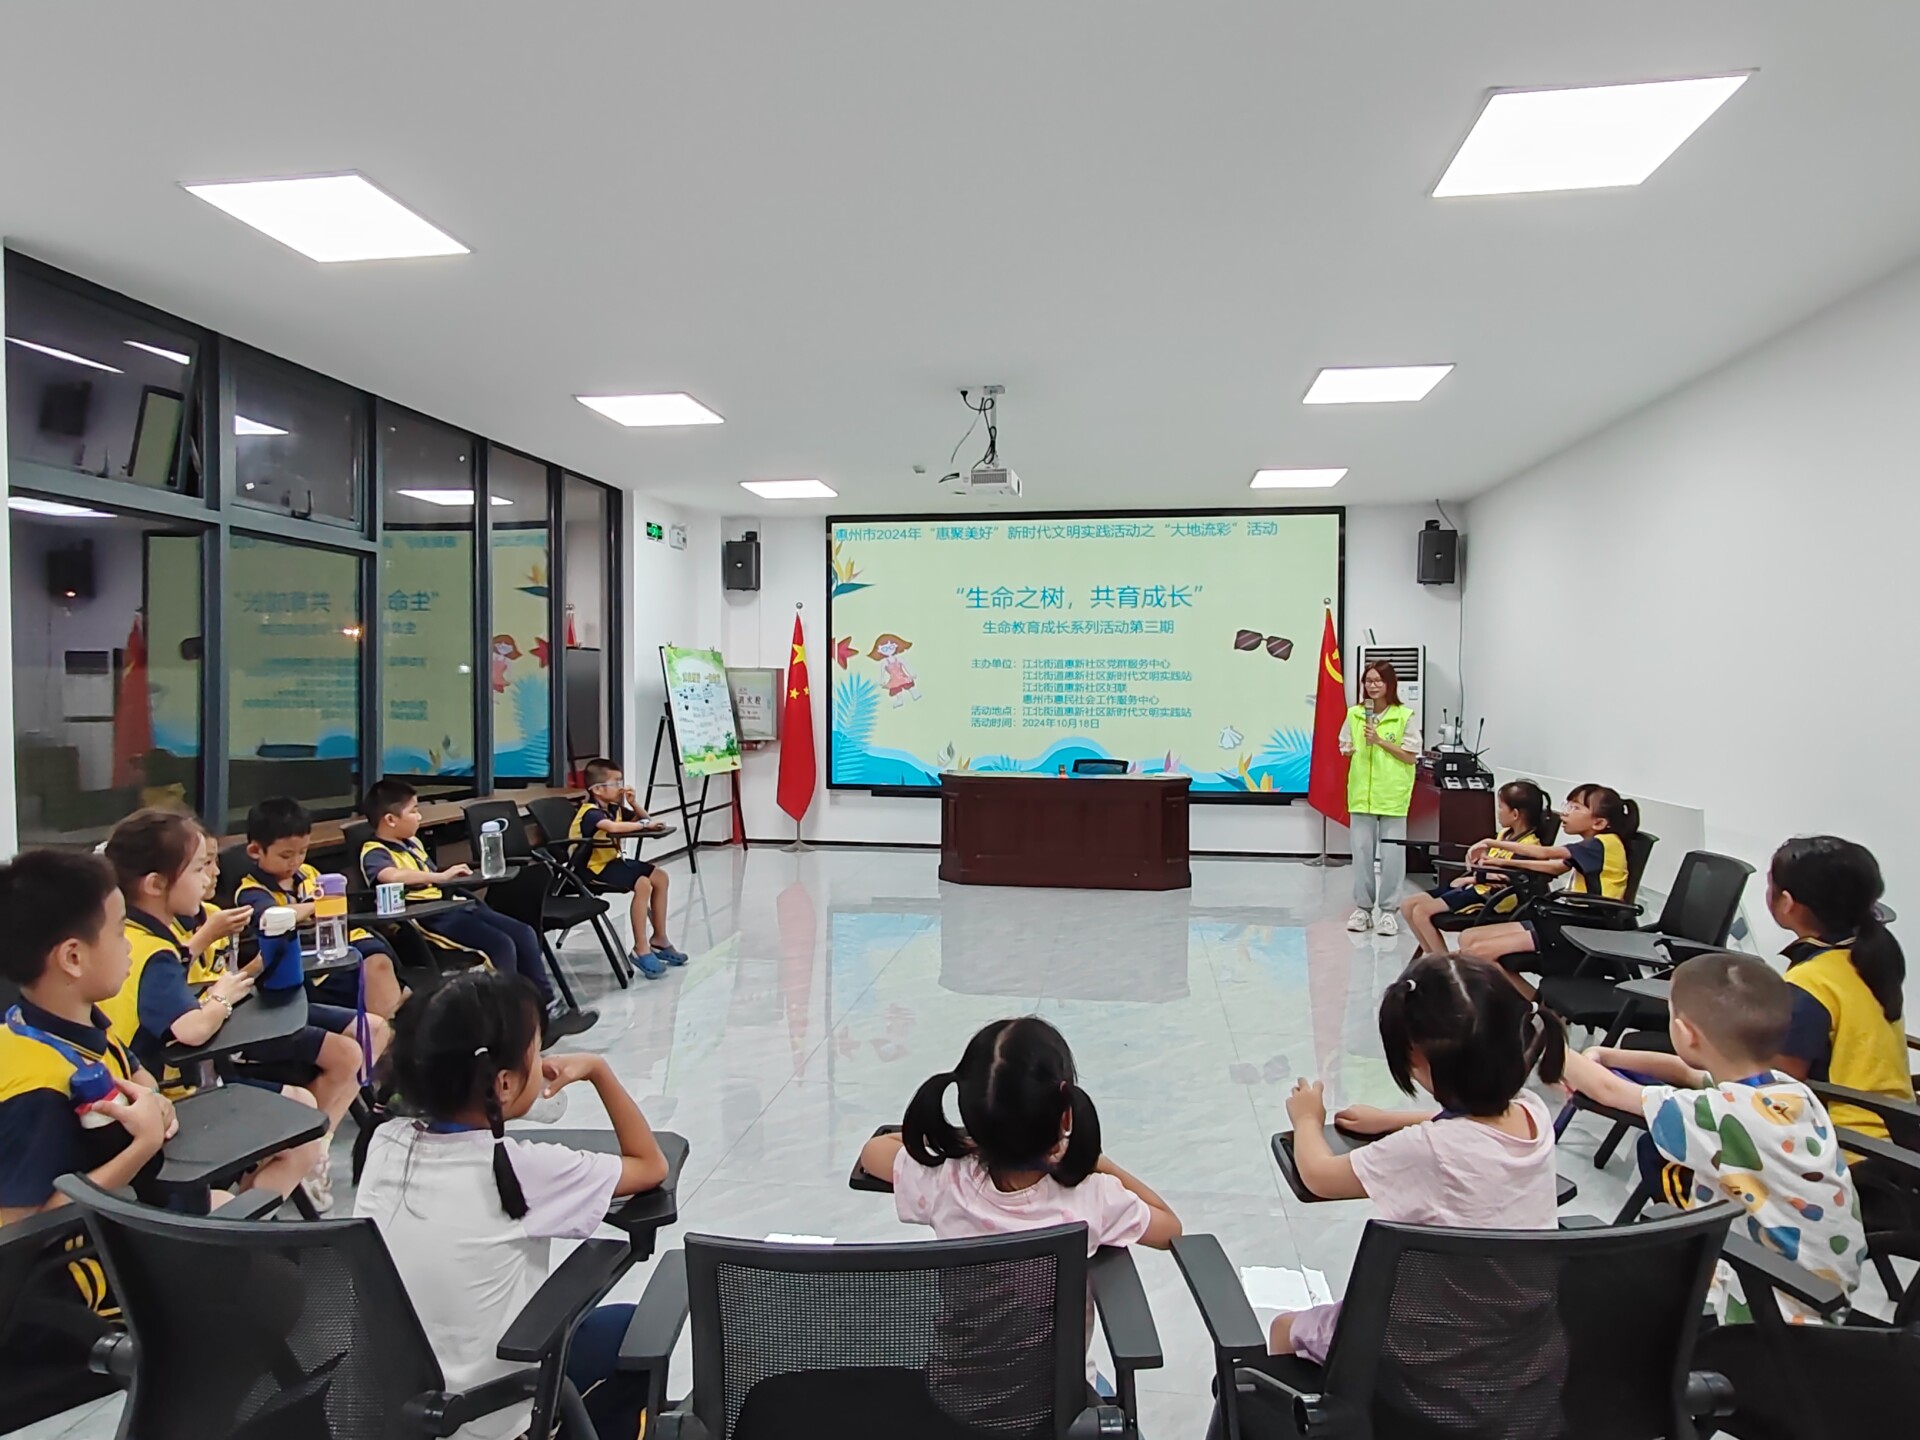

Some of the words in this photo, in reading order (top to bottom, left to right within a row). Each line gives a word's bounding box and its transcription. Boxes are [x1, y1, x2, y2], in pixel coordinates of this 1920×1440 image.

[956, 585, 1203, 610] “生命之树，共育成长”
[982, 619, 1175, 635] 生命教育成长系列活动第三期
[1022, 670, 1192, 681] 江北街道惠新社区新时代文明实践站
[1022, 682, 1127, 693] 江北街道惠新社区妇联
[1022, 694, 1160, 705] 惠州市惠民社会工作服务中心
